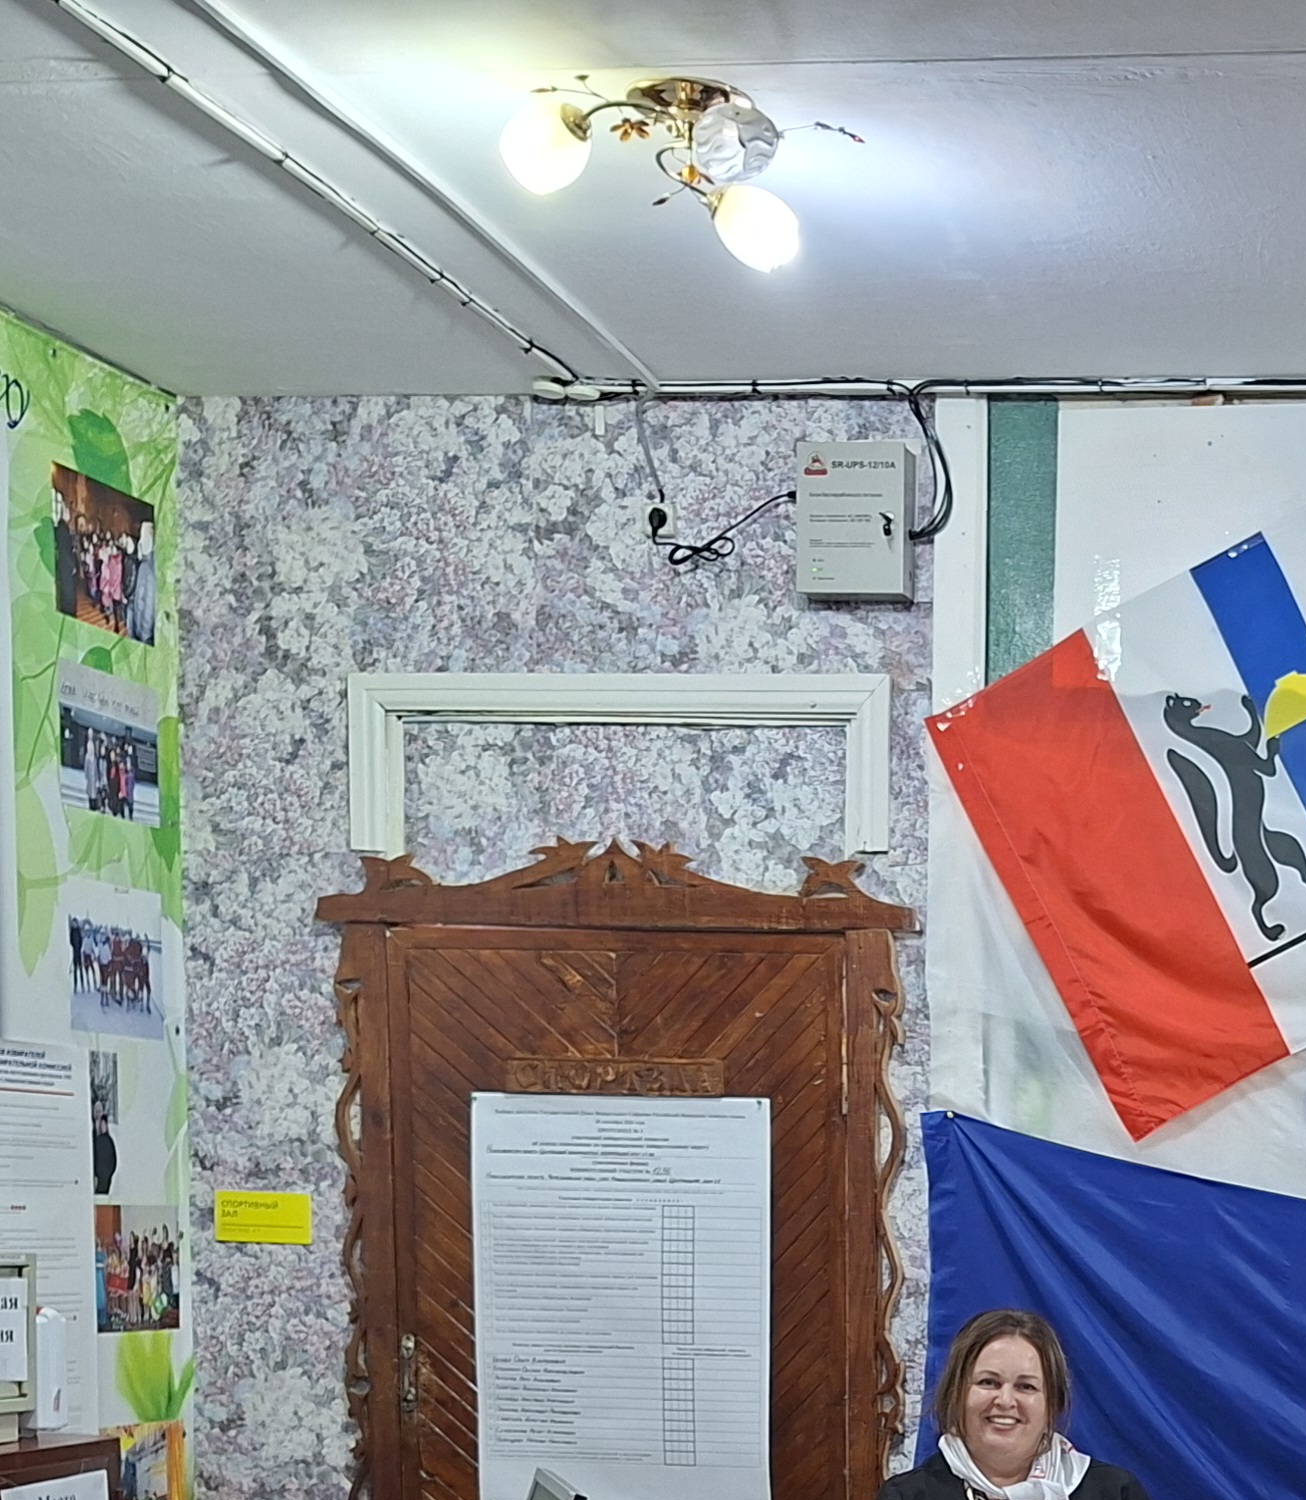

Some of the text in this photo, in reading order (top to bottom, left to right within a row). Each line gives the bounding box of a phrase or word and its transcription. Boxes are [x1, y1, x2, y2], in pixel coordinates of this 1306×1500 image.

[831, 461, 896, 469] SR-UPS-12/10A
[221, 1199, 279, 1209] СПОРТИВНЫЙ
[221, 1209, 239, 1218] ЗАЛ
